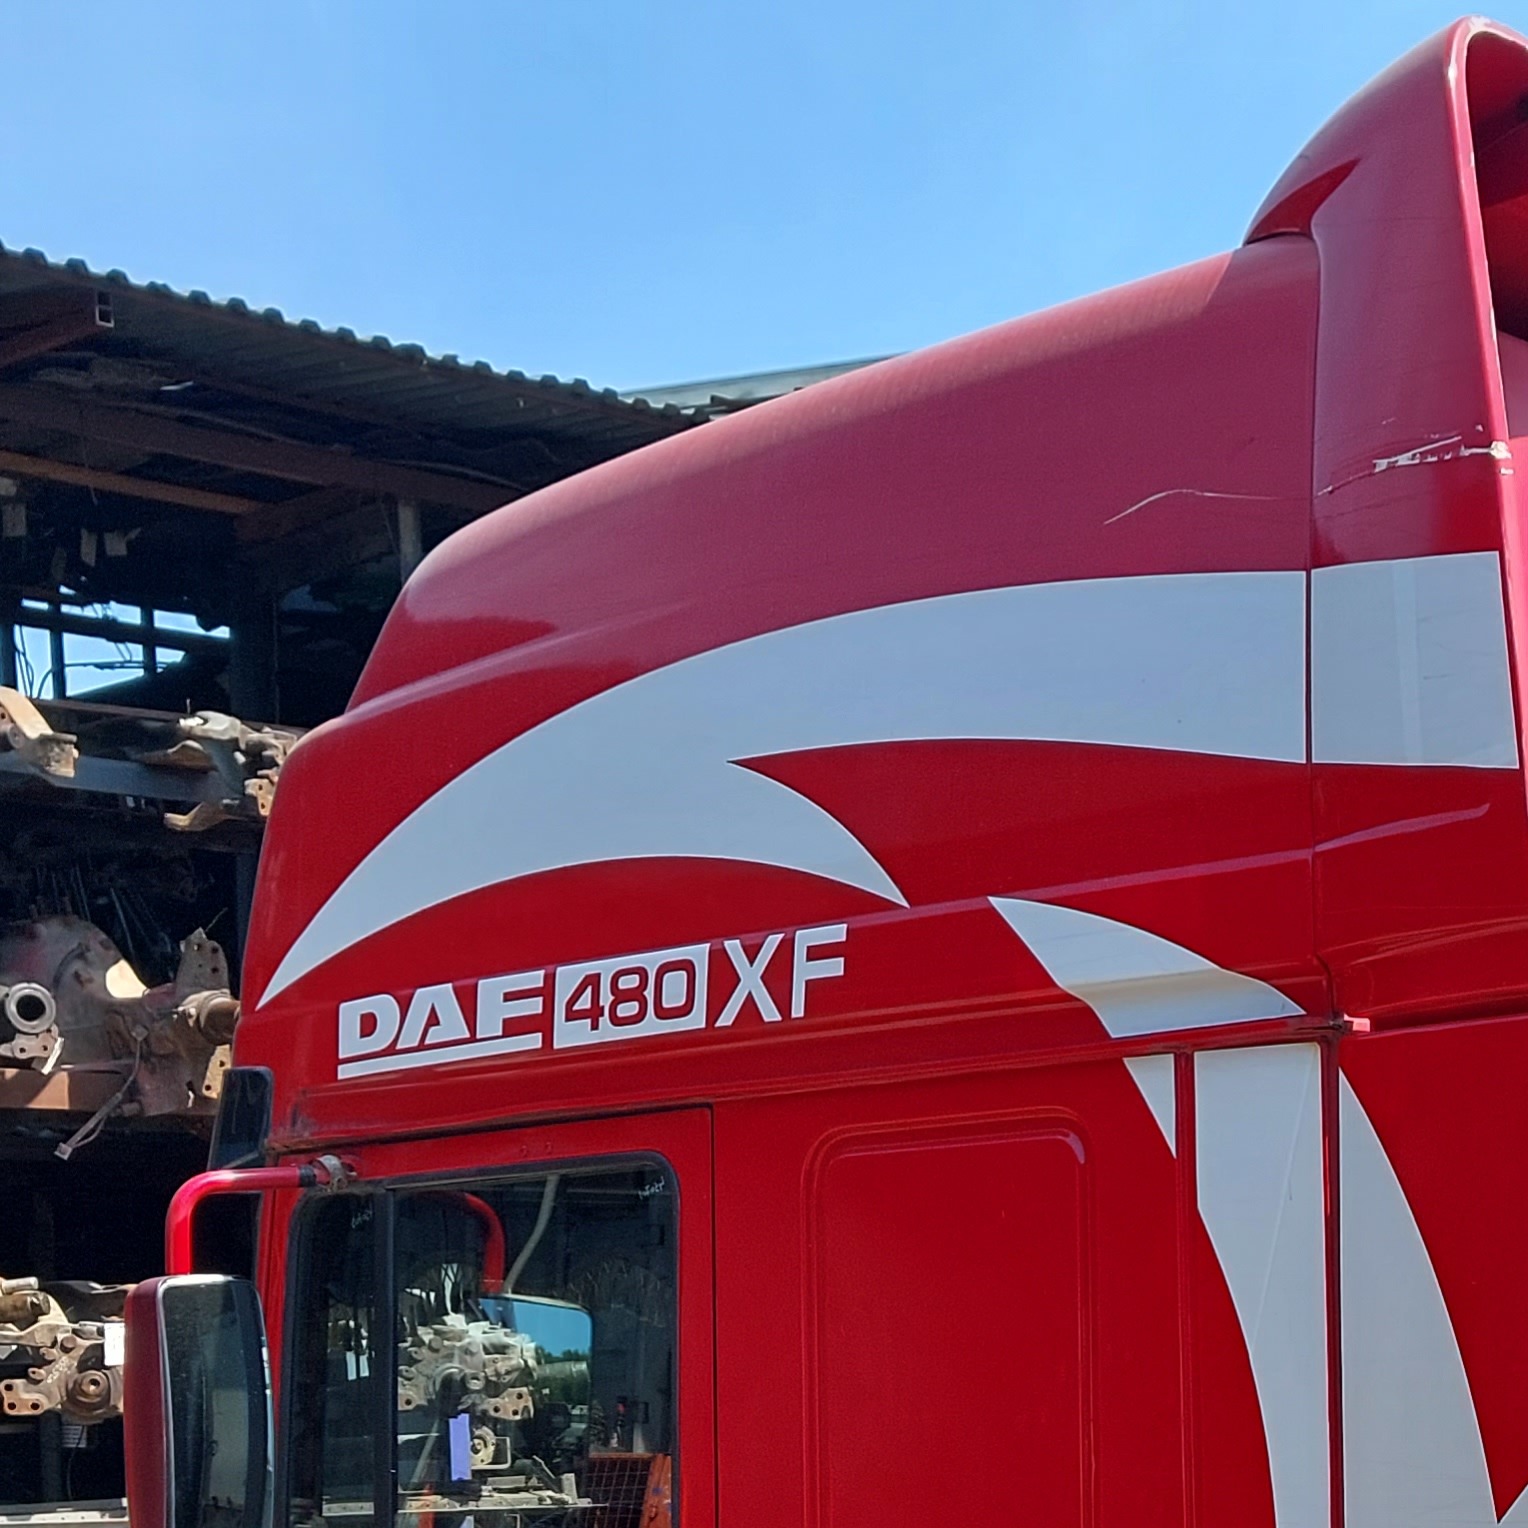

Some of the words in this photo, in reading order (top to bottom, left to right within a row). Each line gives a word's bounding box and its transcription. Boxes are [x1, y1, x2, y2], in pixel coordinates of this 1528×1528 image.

[338, 969, 546, 1061] DAF
[564, 957, 697, 1033] 480
[714, 923, 848, 1028] XF
